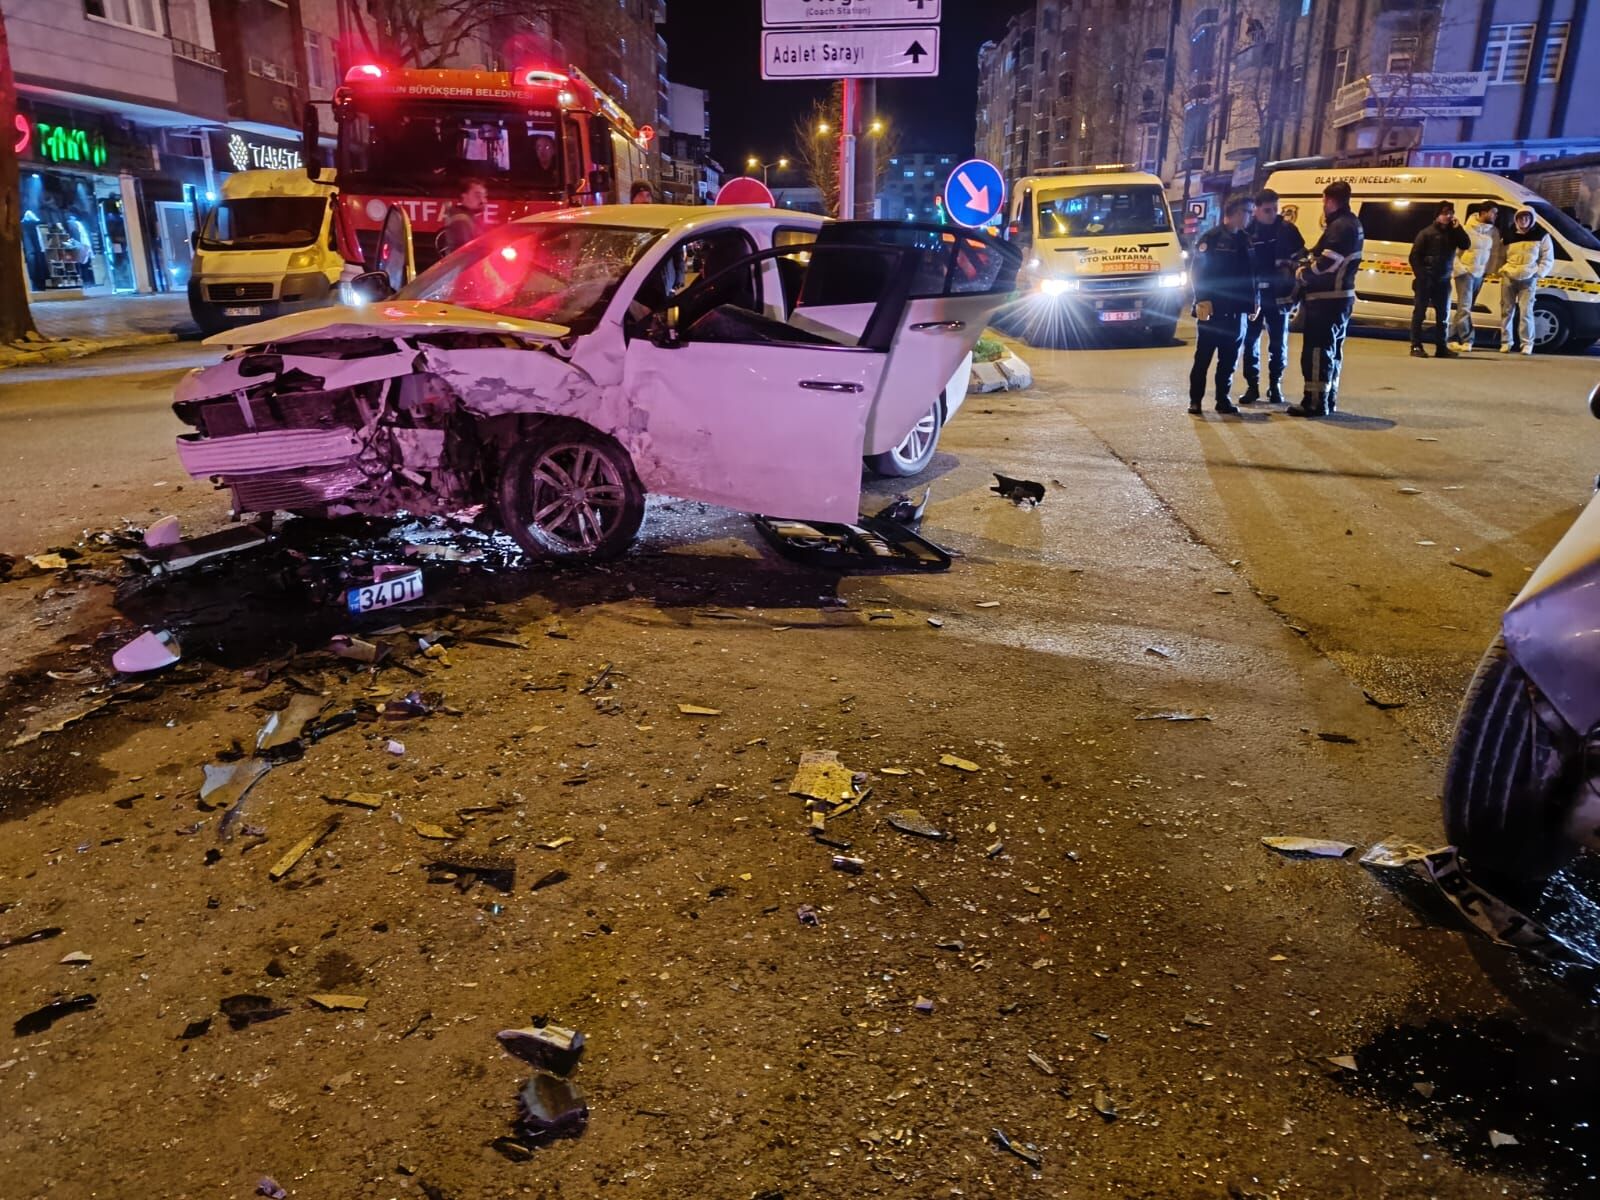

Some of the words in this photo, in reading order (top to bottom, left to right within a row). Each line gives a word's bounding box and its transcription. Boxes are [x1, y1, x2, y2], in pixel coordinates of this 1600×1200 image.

[773, 46, 816, 64] Adalet
[823, 44, 865, 65] Sarayı
[1424, 151, 1510, 169] moda
[1101, 254, 1153, 262] KURTARMA
[361, 585, 388, 610] 34
